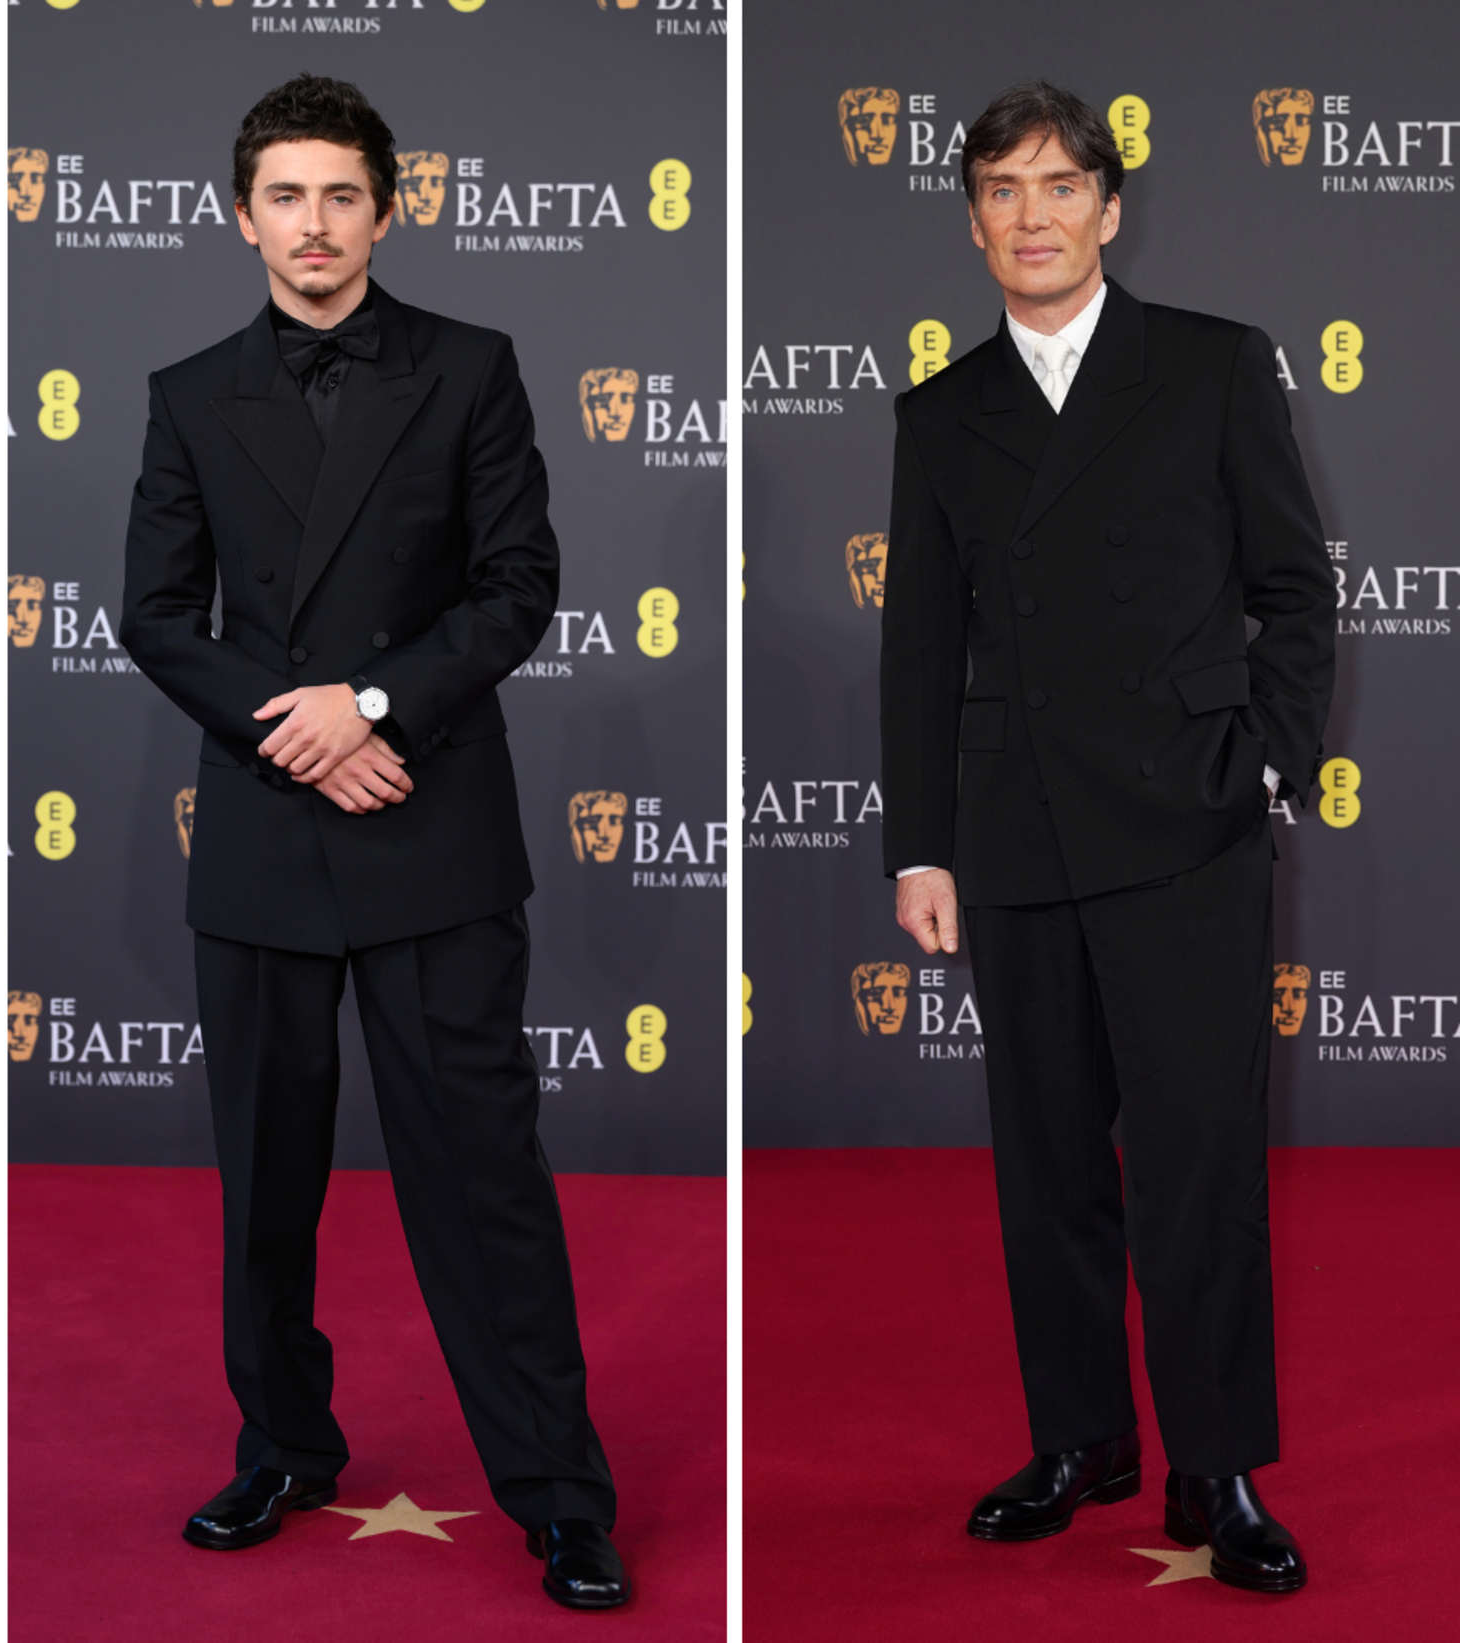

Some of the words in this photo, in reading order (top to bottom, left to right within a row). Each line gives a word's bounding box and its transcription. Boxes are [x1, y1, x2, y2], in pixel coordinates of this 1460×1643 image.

[251, 16, 297, 33] FILM
[301, 16, 381, 34] AWARDS
[656, 18, 701, 35] FILM
[908, 94, 936, 114] EE
[1323, 95, 1351, 115] EE
[56, 154, 84, 174] EE
[457, 157, 484, 178] EE
[909, 174, 956, 192] FILM
[1322, 175, 1369, 193] FILM
[1373, 175, 1455, 193] AWARDS
[57, 180, 226, 224] BAFTA
[456, 183, 626, 227] BAFTA
[56, 232, 97, 248] FILM
[102, 232, 183, 249] AWARDS
[455, 234, 500, 252] FILM
[504, 235, 584, 252] AWARDS
[646, 374, 674, 394] EE
[763, 398, 844, 415] AWARDS
[644, 450, 690, 467] FILM
[53, 581, 80, 601] EE
[1374, 619, 1451, 635] AWARDS
[52, 656, 97, 673] FILM
[635, 797, 662, 816] EE
[742, 781, 882, 823] AFTA
[771, 832, 850, 848] AWARDS
[632, 871, 677, 888] FILM
[919, 968, 946, 987] EE
[1319, 970, 1346, 989] EE
[49, 997, 76, 1017] EE
[1320, 995, 1460, 1037] BAFT
[50, 1021, 206, 1065] BAFTA
[919, 1043, 964, 1059] FILM
[1318, 1045, 1363, 1061] FILM
[1368, 1045, 1447, 1062] AWARDS
[48, 1070, 93, 1086] FILM
[97, 1070, 174, 1087] AWARDS
